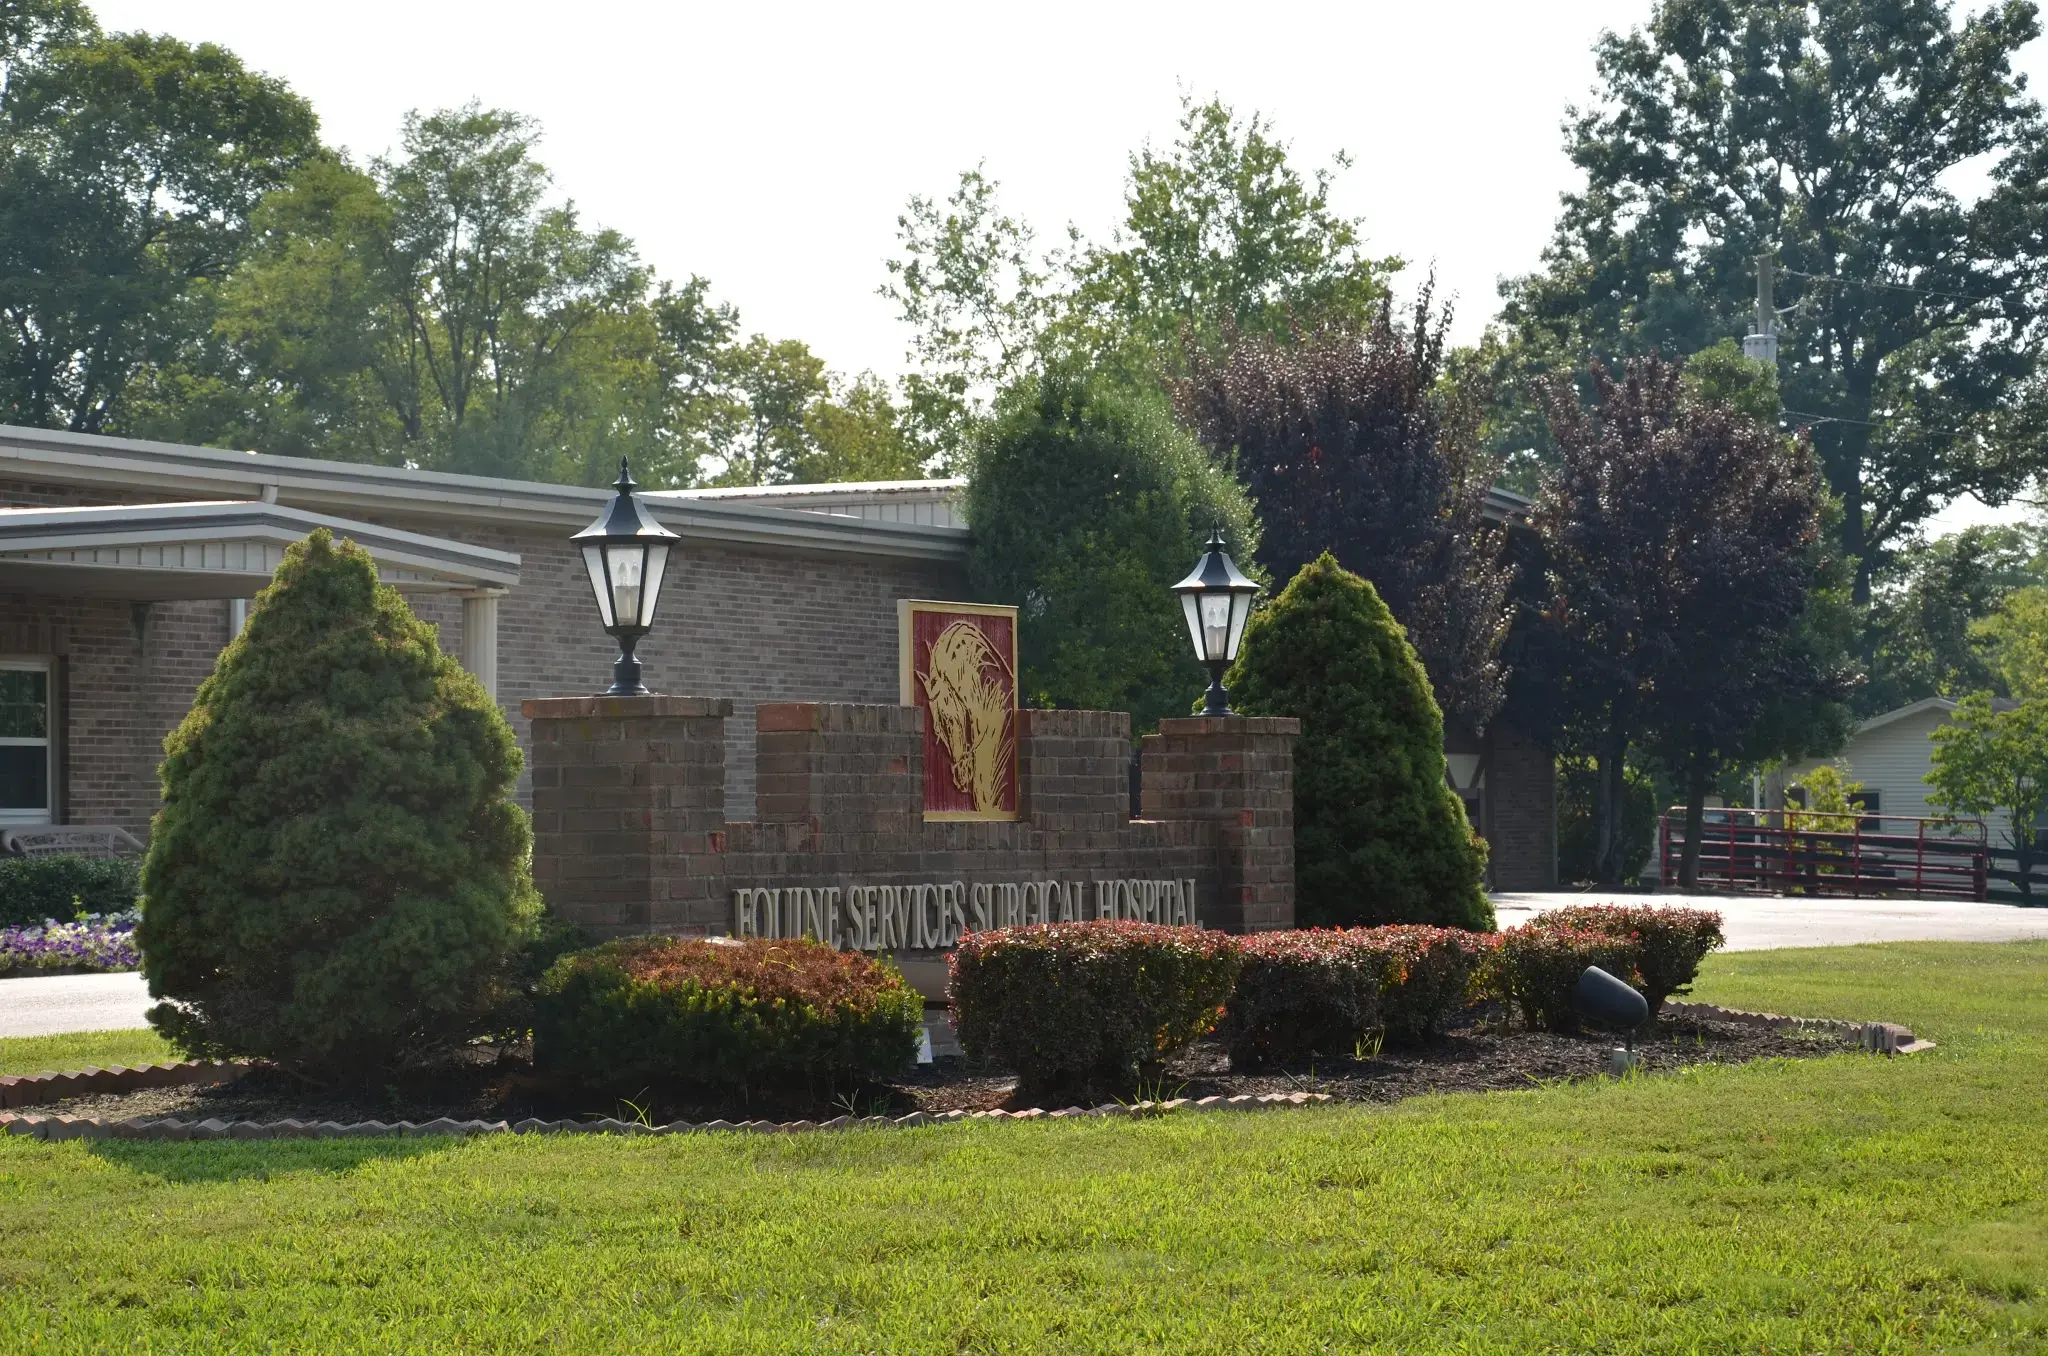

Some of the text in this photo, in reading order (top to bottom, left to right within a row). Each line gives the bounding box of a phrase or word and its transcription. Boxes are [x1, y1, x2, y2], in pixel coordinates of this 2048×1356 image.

[734, 877, 1204, 951] EQUINE SERVICES SURGICAL HOSPITAL
